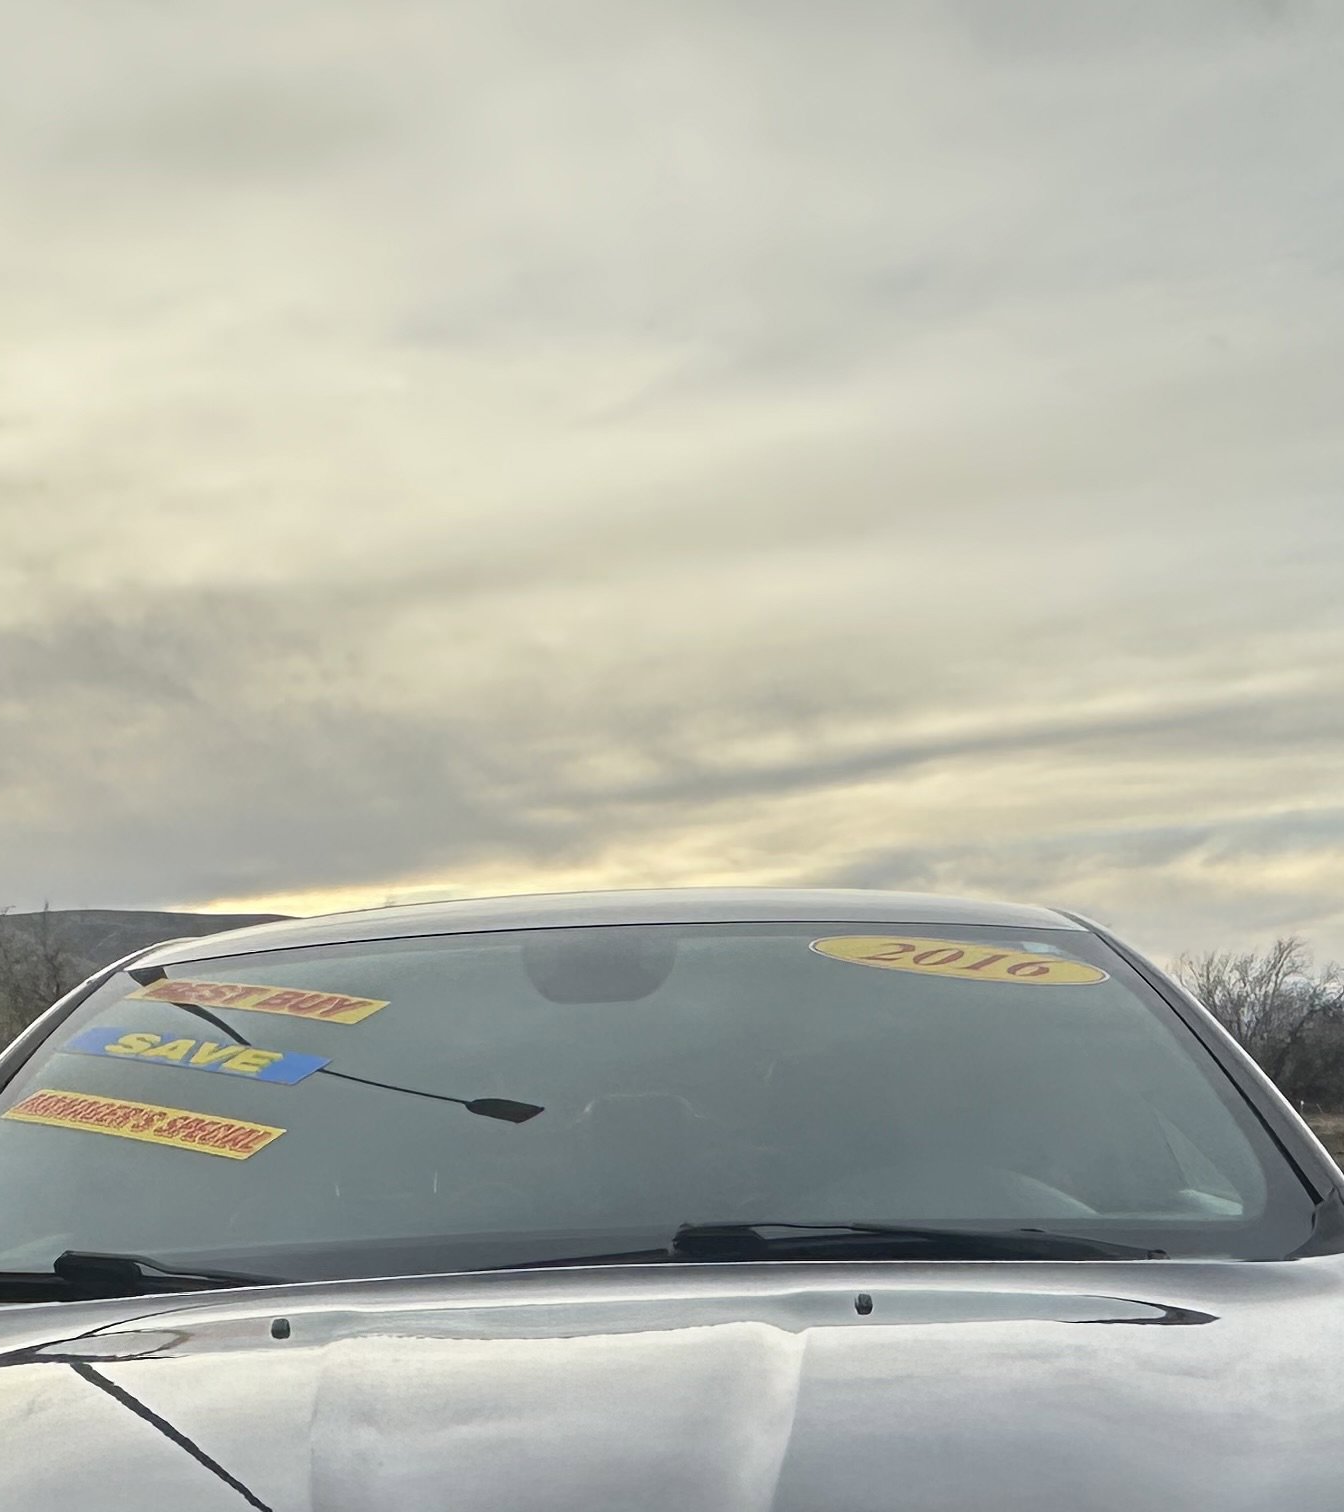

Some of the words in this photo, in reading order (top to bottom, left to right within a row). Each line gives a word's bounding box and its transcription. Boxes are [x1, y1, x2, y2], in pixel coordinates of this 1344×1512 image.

[857, 942, 1052, 977] 2016
[104, 1032, 283, 1075] SAVE
[153, 1115, 272, 1153] SPECIAL
